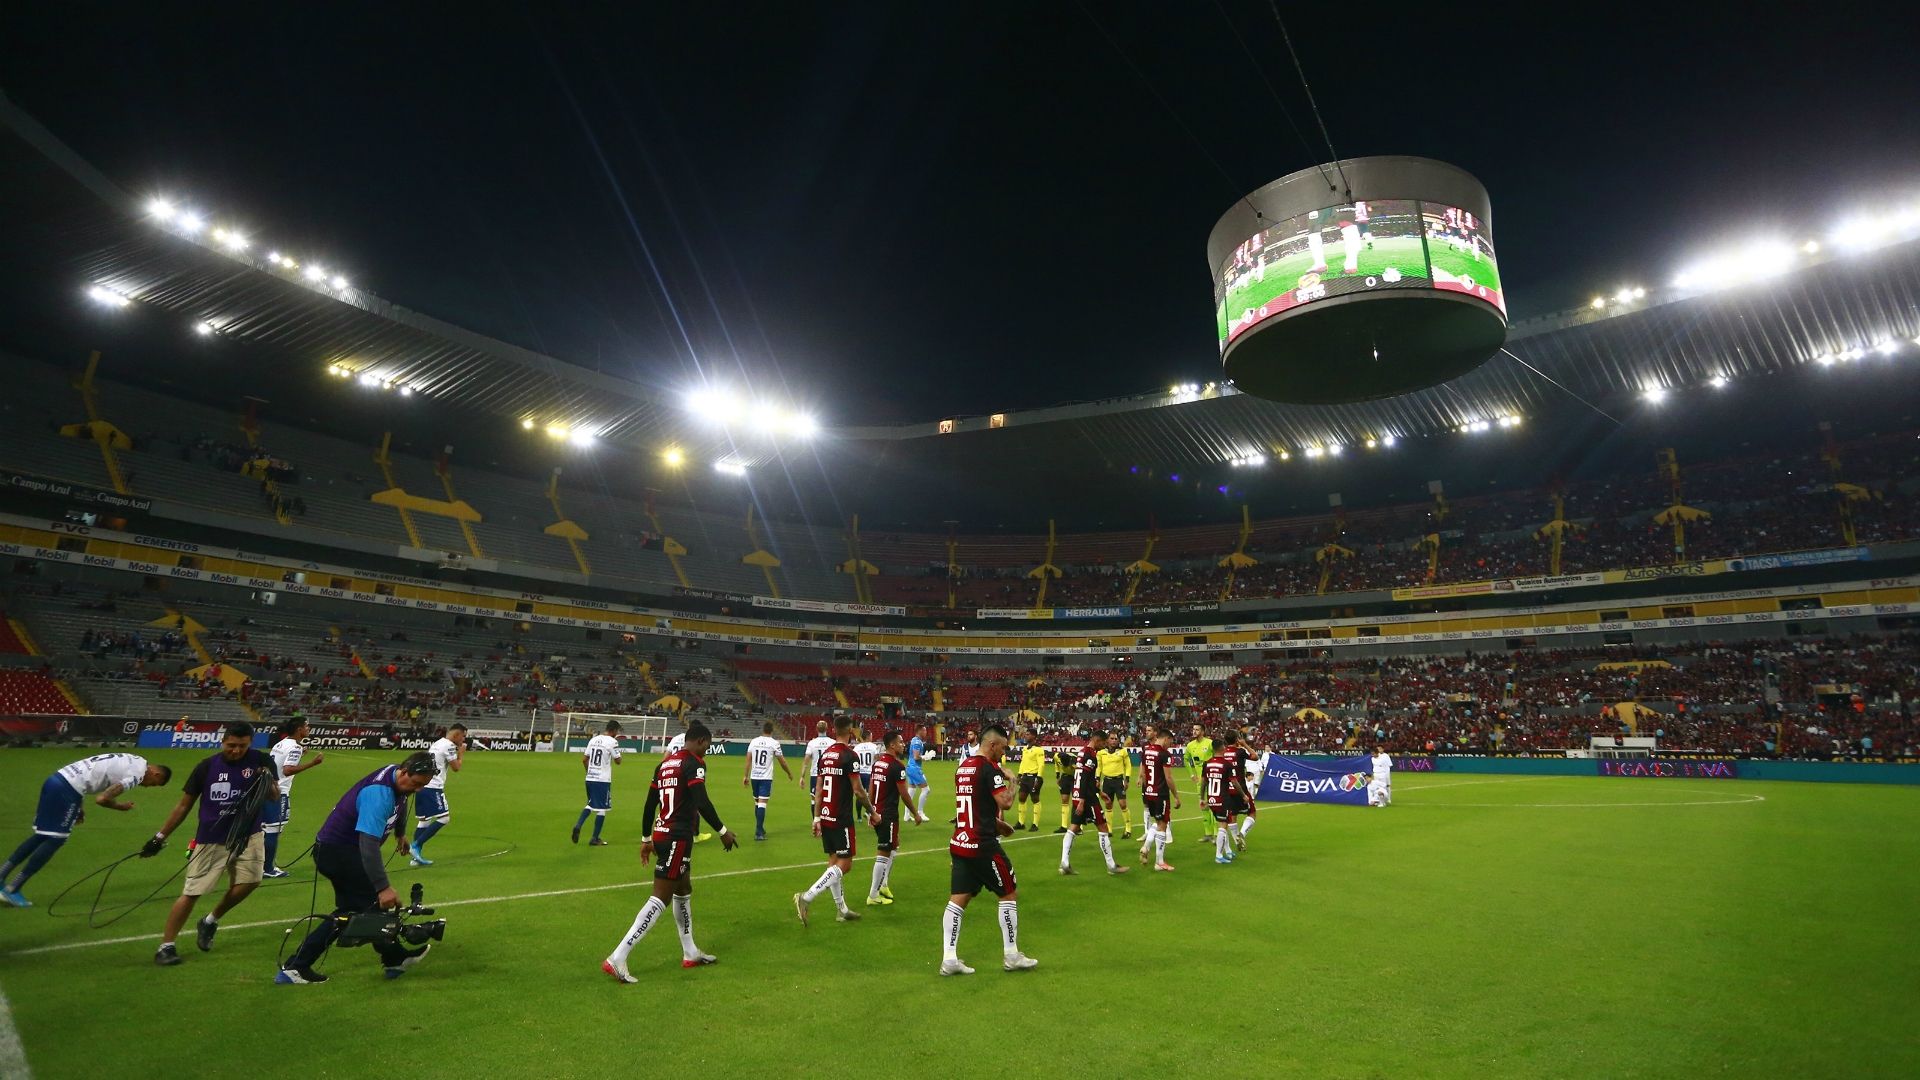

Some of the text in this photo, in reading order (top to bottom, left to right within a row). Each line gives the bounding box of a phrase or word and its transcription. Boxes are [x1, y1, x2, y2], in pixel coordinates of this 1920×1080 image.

[12, 476, 47, 493] Campo
[49, 481, 71, 496] Azul
[97, 492, 128, 508] Campo
[128, 497, 150, 511] Azul
[50, 523, 90, 535] PVC
[134, 536, 199, 552] CEMENTOS
[0, 543, 20, 554] obil
[35, 549, 69, 561] Mobil
[83, 556, 115, 568] Mobil
[128, 562, 159, 573] Mobil
[171, 568, 199, 579] Mobil
[211, 574, 238, 584] Mobil
[249, 579, 274, 589] Mobil
[285, 584, 310, 593] Mobil
[319, 588, 343, 597] Mobil
[353, 592, 376, 601] Mobil
[385, 597, 407, 606] Mobil
[416, 601, 437, 609] Mobil
[446, 604, 466, 613] Mobil
[475, 607, 494, 616] Mobil
[503, 611, 522, 619] Mobil
[531, 614, 549, 622] Mobil
[558, 617, 576, 625] Mobil
[583, 620, 601, 628] Mobil
[608, 622, 626, 630] Mobil
[657, 627, 674, 635] Mobil
[681, 629, 698, 637] Mobil
[705, 631, 721, 639] Mobil
[1870, 578, 1911, 588] PVC
[521, 593, 545, 601] PVC
[570, 600, 609, 610] TUBERIAS
[762, 599, 791, 608] acesta
[1471, 631, 1492, 639] Mobil
[1502, 629, 1525, 637] Mobil
[1565, 625, 1589, 633] Mobil
[1598, 623, 1623, 631] Mobil
[1633, 621, 1659, 629] Mobil
[1669, 618, 1695, 627] Mobil
[1706, 616, 1735, 624] Mobil
[1745, 613, 1774, 622] Mobil
[1787, 610, 1817, 620] Mobil
[1829, 607, 1861, 617] Mobil
[1874, 603, 1909, 614] Mobil
[171, 732, 224, 743] PERDU
[299, 736, 367, 746] camcar
[591, 748, 603, 767] 18
[755, 749, 768, 767] 16
[860, 752, 872, 766] 10
[1147, 765, 1155, 786] 3
[1268, 768, 1299, 781] LIGA
[823, 776, 833, 803] 9
[874, 780, 881, 805] 7
[1208, 777, 1222, 797] 10
[1280, 779, 1337, 794] BBVA
[659, 787, 675, 821] 17
[956, 795, 974, 829] 21
[627, 905, 659, 946] PERDURA
[1004, 909, 1015, 944] PERDURA
